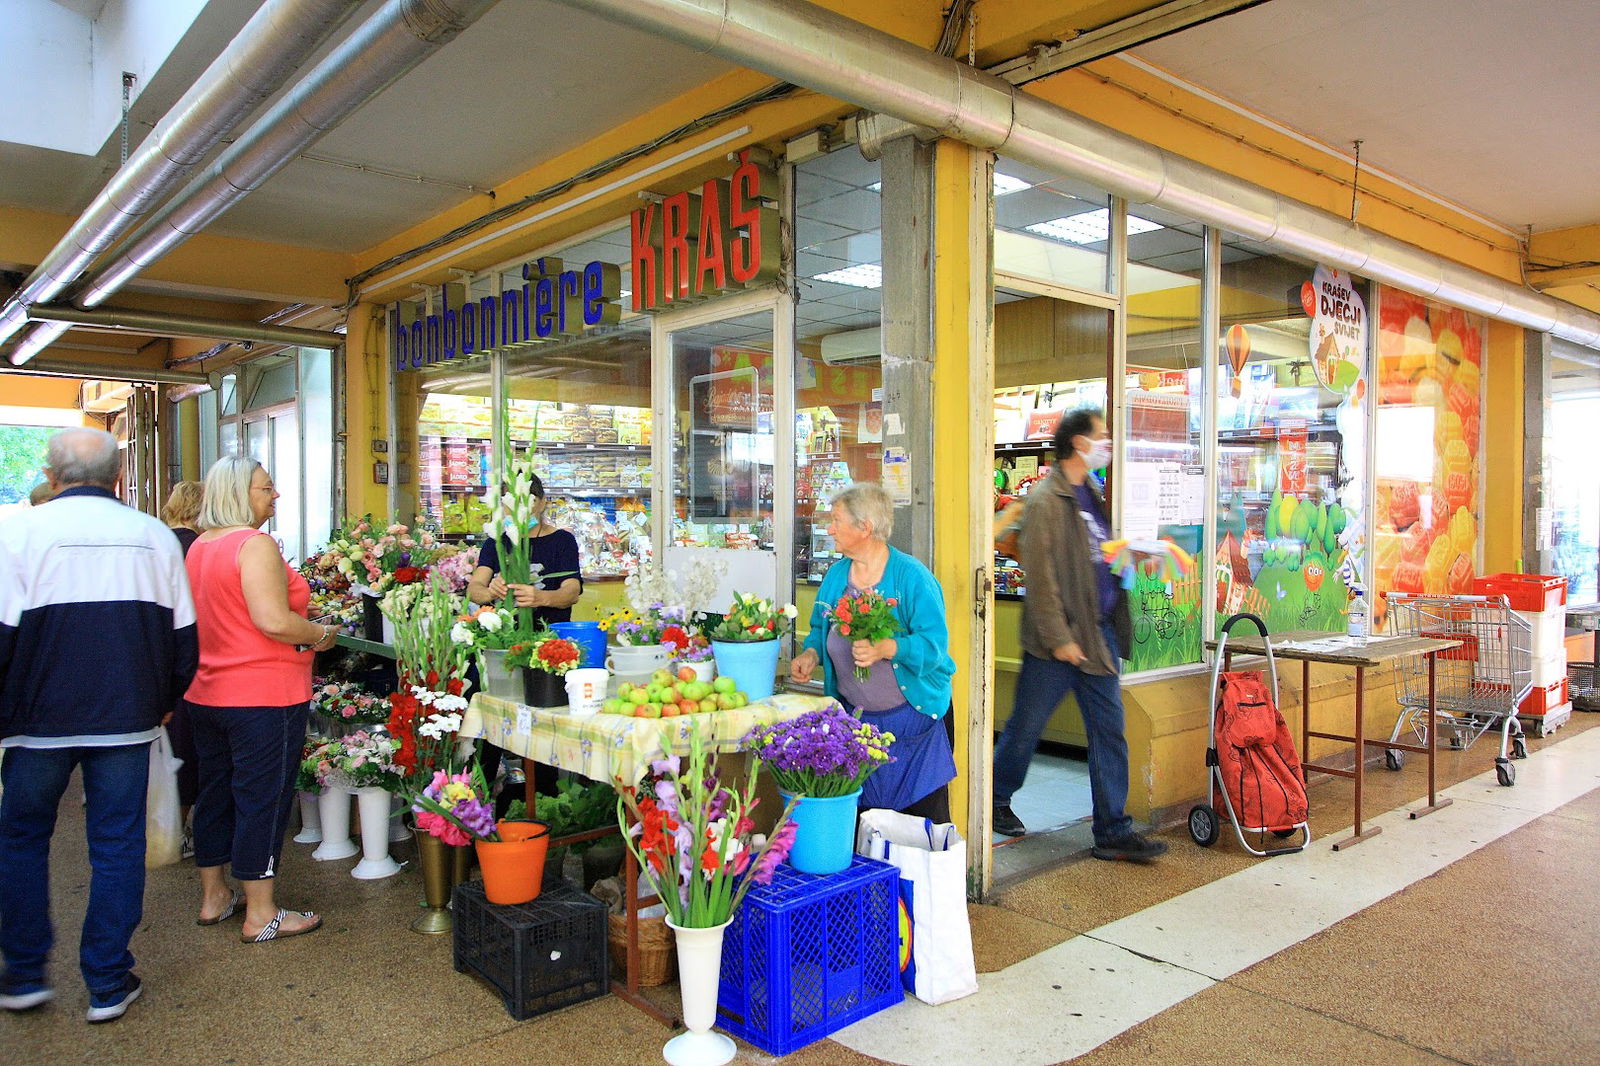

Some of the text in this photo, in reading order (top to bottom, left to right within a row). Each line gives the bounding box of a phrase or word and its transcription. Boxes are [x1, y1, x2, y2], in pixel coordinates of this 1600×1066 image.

[397, 149, 761, 371] bonbonnière KRAŠ
[1322, 281, 1351, 302] KRAŠEV
[1334, 321, 1360, 341] SVIJET
